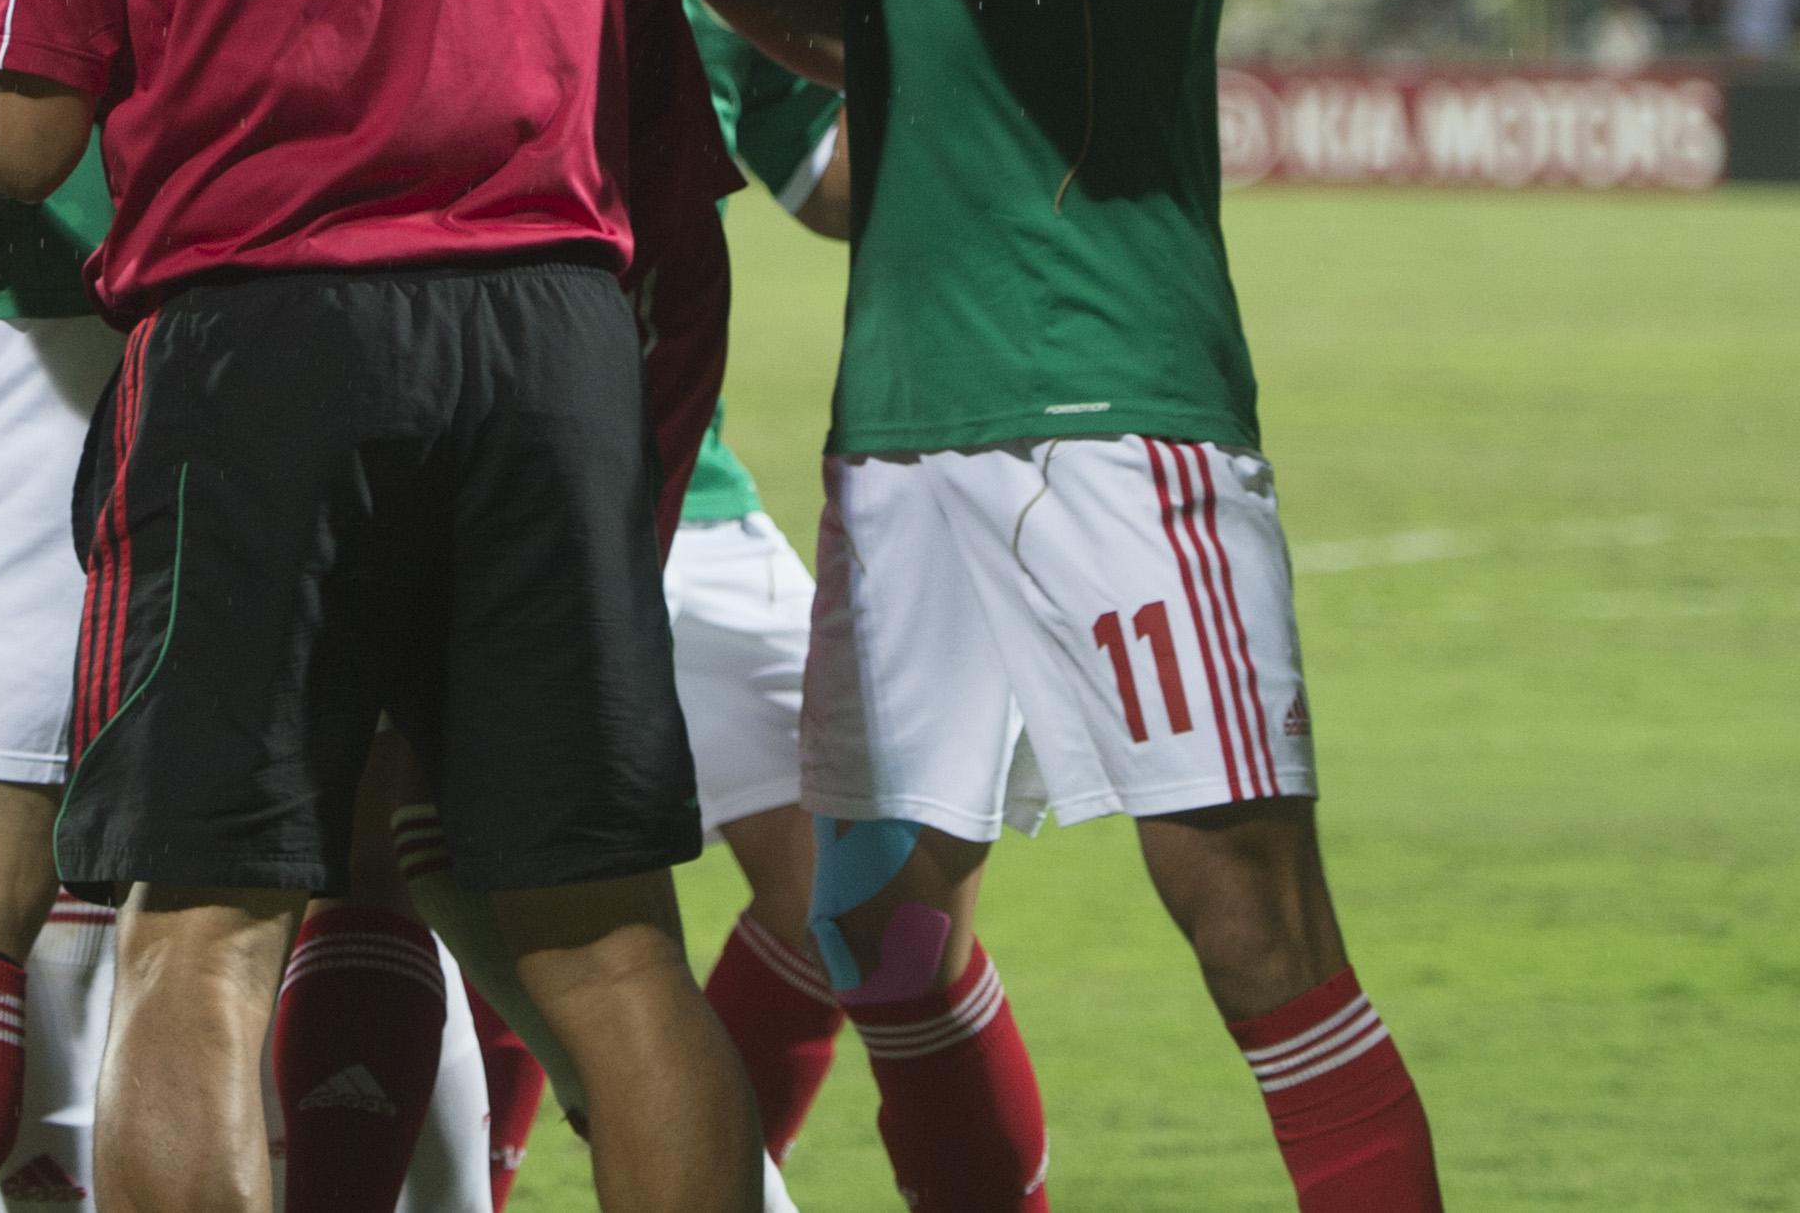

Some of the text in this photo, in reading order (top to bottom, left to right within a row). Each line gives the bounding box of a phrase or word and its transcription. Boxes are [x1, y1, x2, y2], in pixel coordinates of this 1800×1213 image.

[1290, 81, 1727, 184] KIA MOTORS
[1092, 601, 1194, 744] 11
